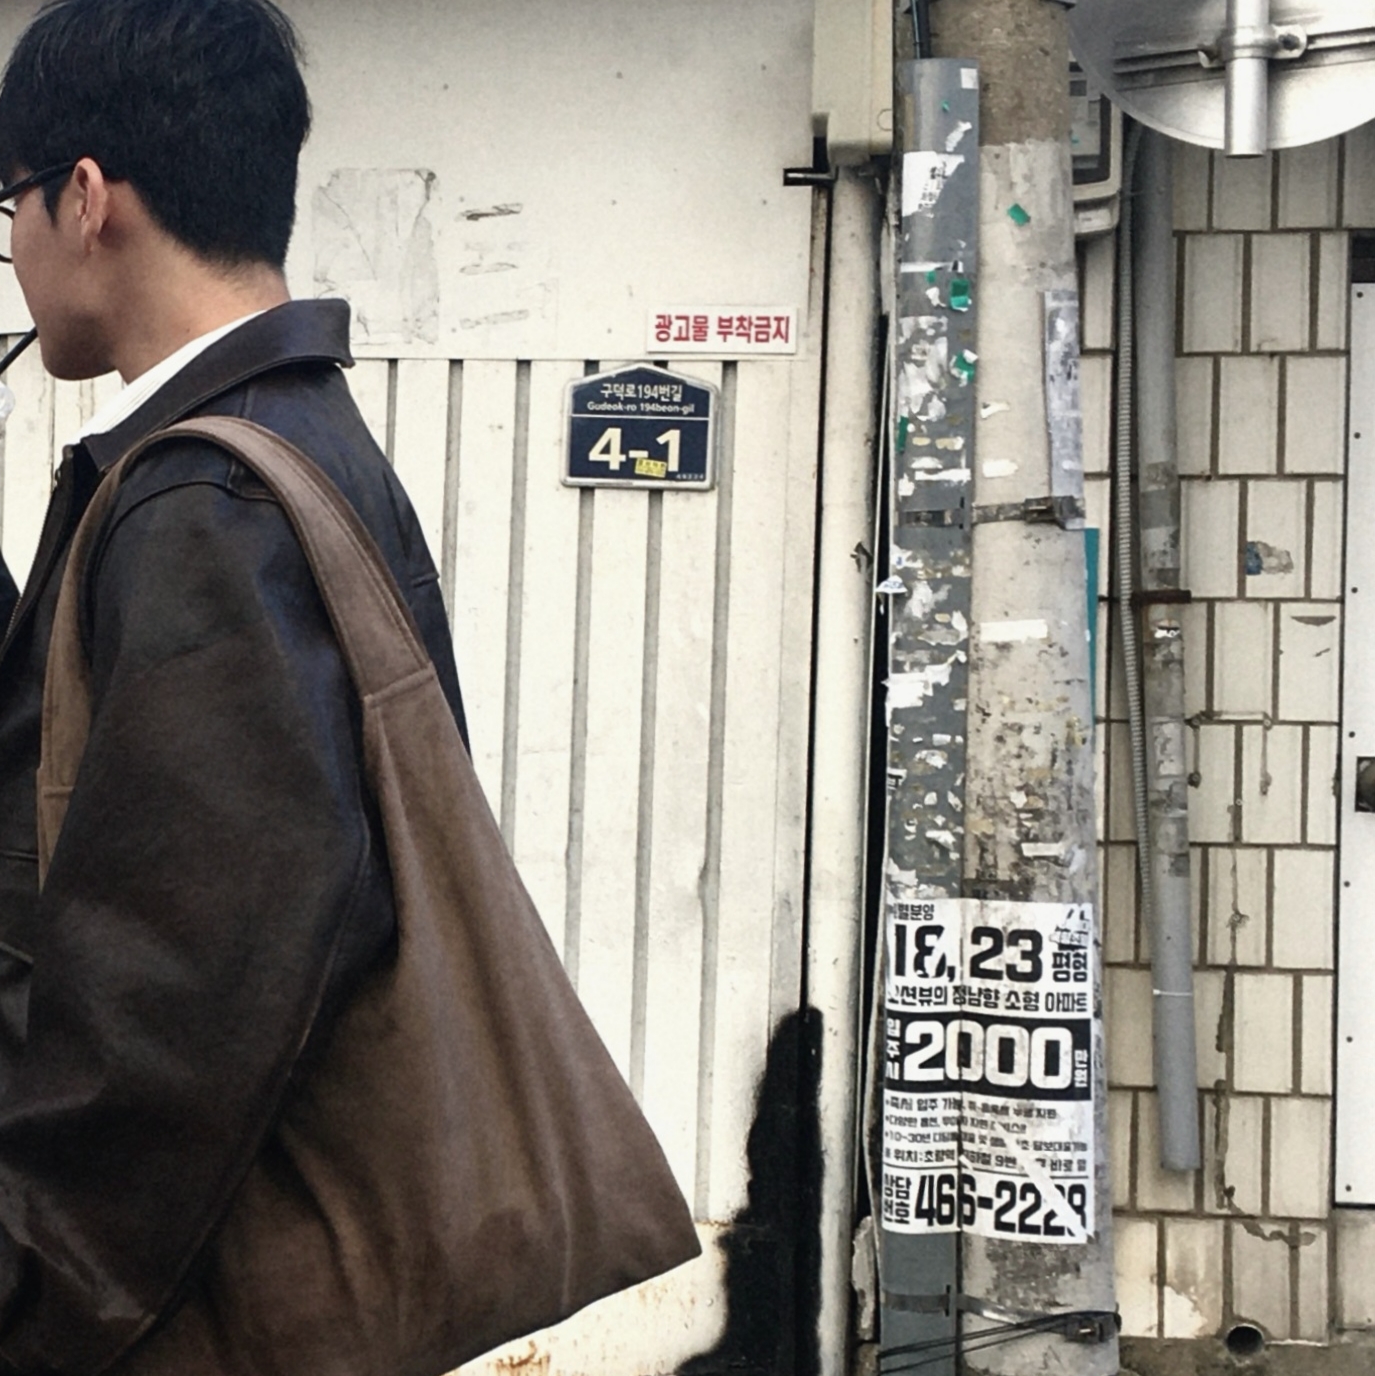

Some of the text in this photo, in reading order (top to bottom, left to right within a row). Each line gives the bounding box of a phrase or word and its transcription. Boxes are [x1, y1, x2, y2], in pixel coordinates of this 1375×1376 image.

[655, 315, 790, 343] 광고물 부착금지
[600, 383, 683, 402] 구덕로194번길
[587, 401, 695, 416] Gudeok-ro 194beon-gil
[588, 427, 682, 473] 4-1
[893, 902, 935, 921] 별분양
[969, 926, 1043, 983] 23
[1052, 951, 1088, 983] 평형
[888, 985, 1088, 1012] 션뷰의 정남향 소형 아파트
[904, 1019, 1073, 1089] 2000
[917, 1098, 938, 1111] 입주
